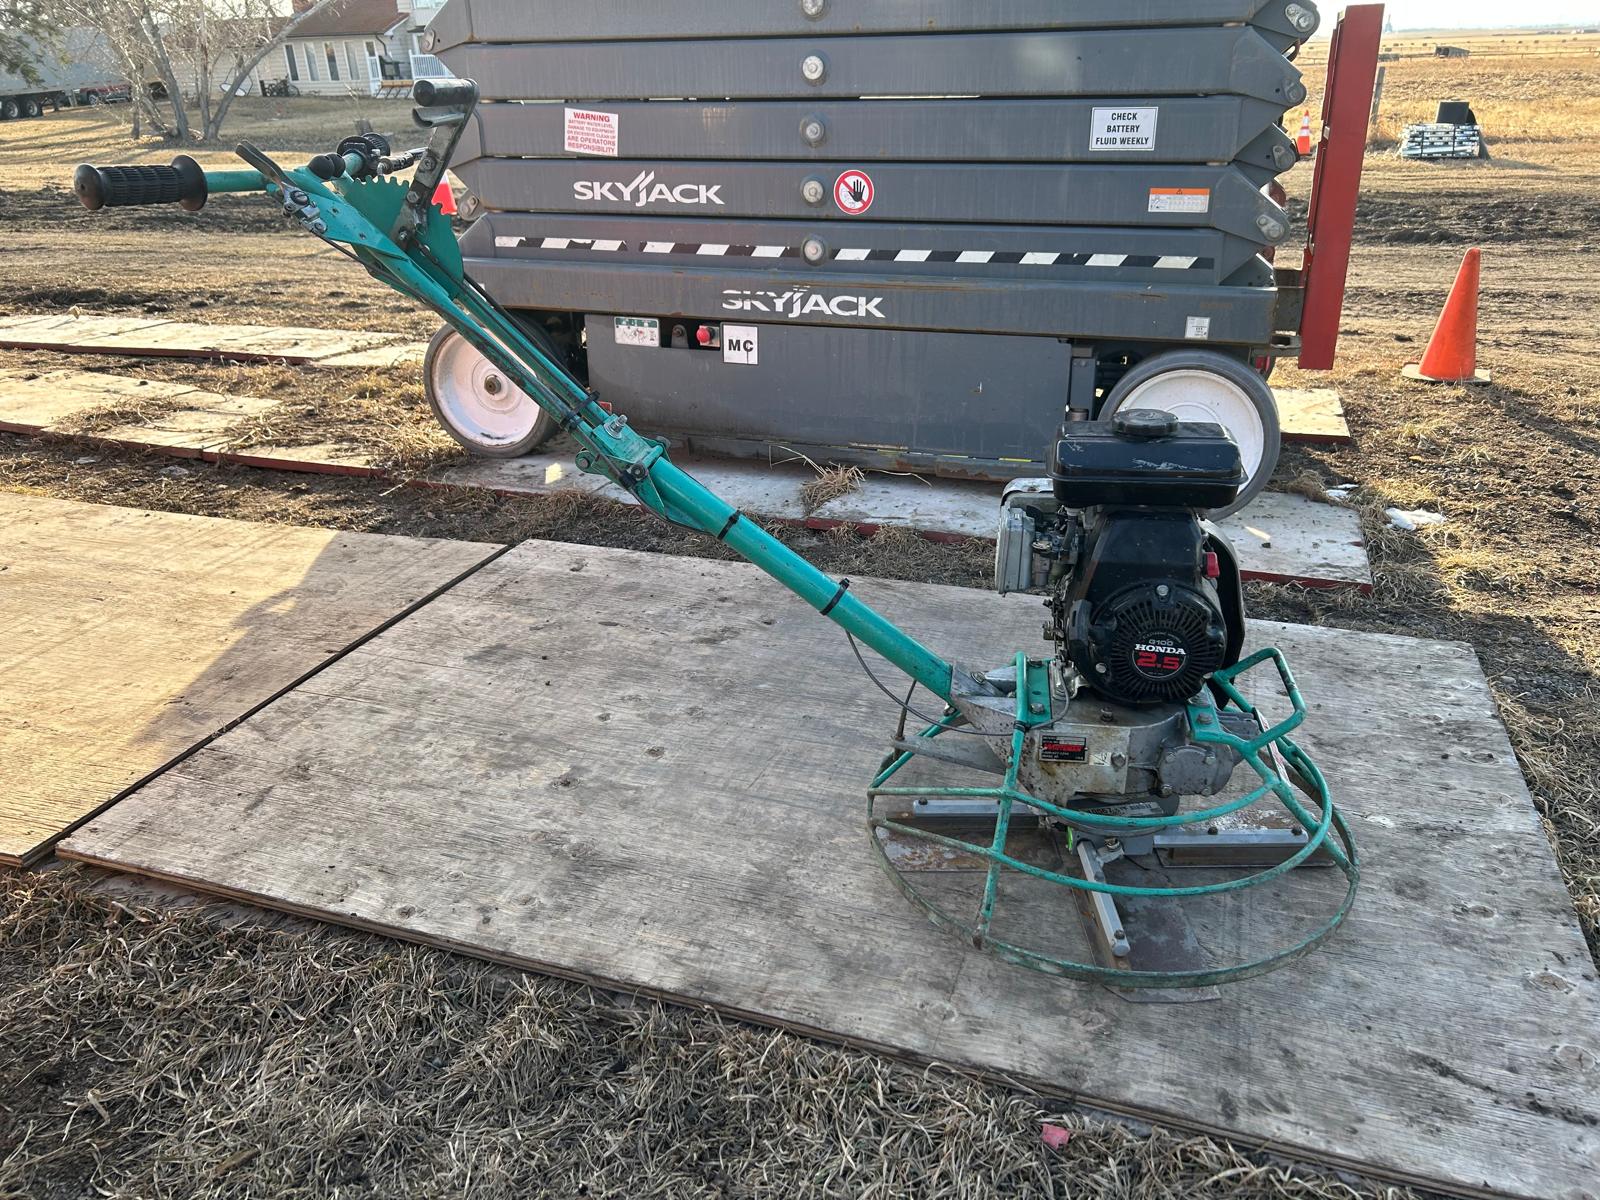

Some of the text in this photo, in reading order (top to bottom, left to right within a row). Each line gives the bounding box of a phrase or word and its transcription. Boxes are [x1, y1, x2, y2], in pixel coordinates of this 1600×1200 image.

[573, 112, 610, 122] WARNING
[1111, 112, 1138, 121] CHECK
[1106, 124, 1140, 133] BATTERY
[580, 136, 616, 146] OPERATORS
[1095, 137, 1150, 145] FLUID WEEKLY
[568, 142, 614, 152] RESPONSIBILITY
[573, 170, 725, 207] SKYJACK
[722, 284, 886, 318] SKYJACK
[728, 339, 754, 352] MC
[1134, 643, 1187, 655] HONDA
[1135, 651, 1180, 671] 2.5
